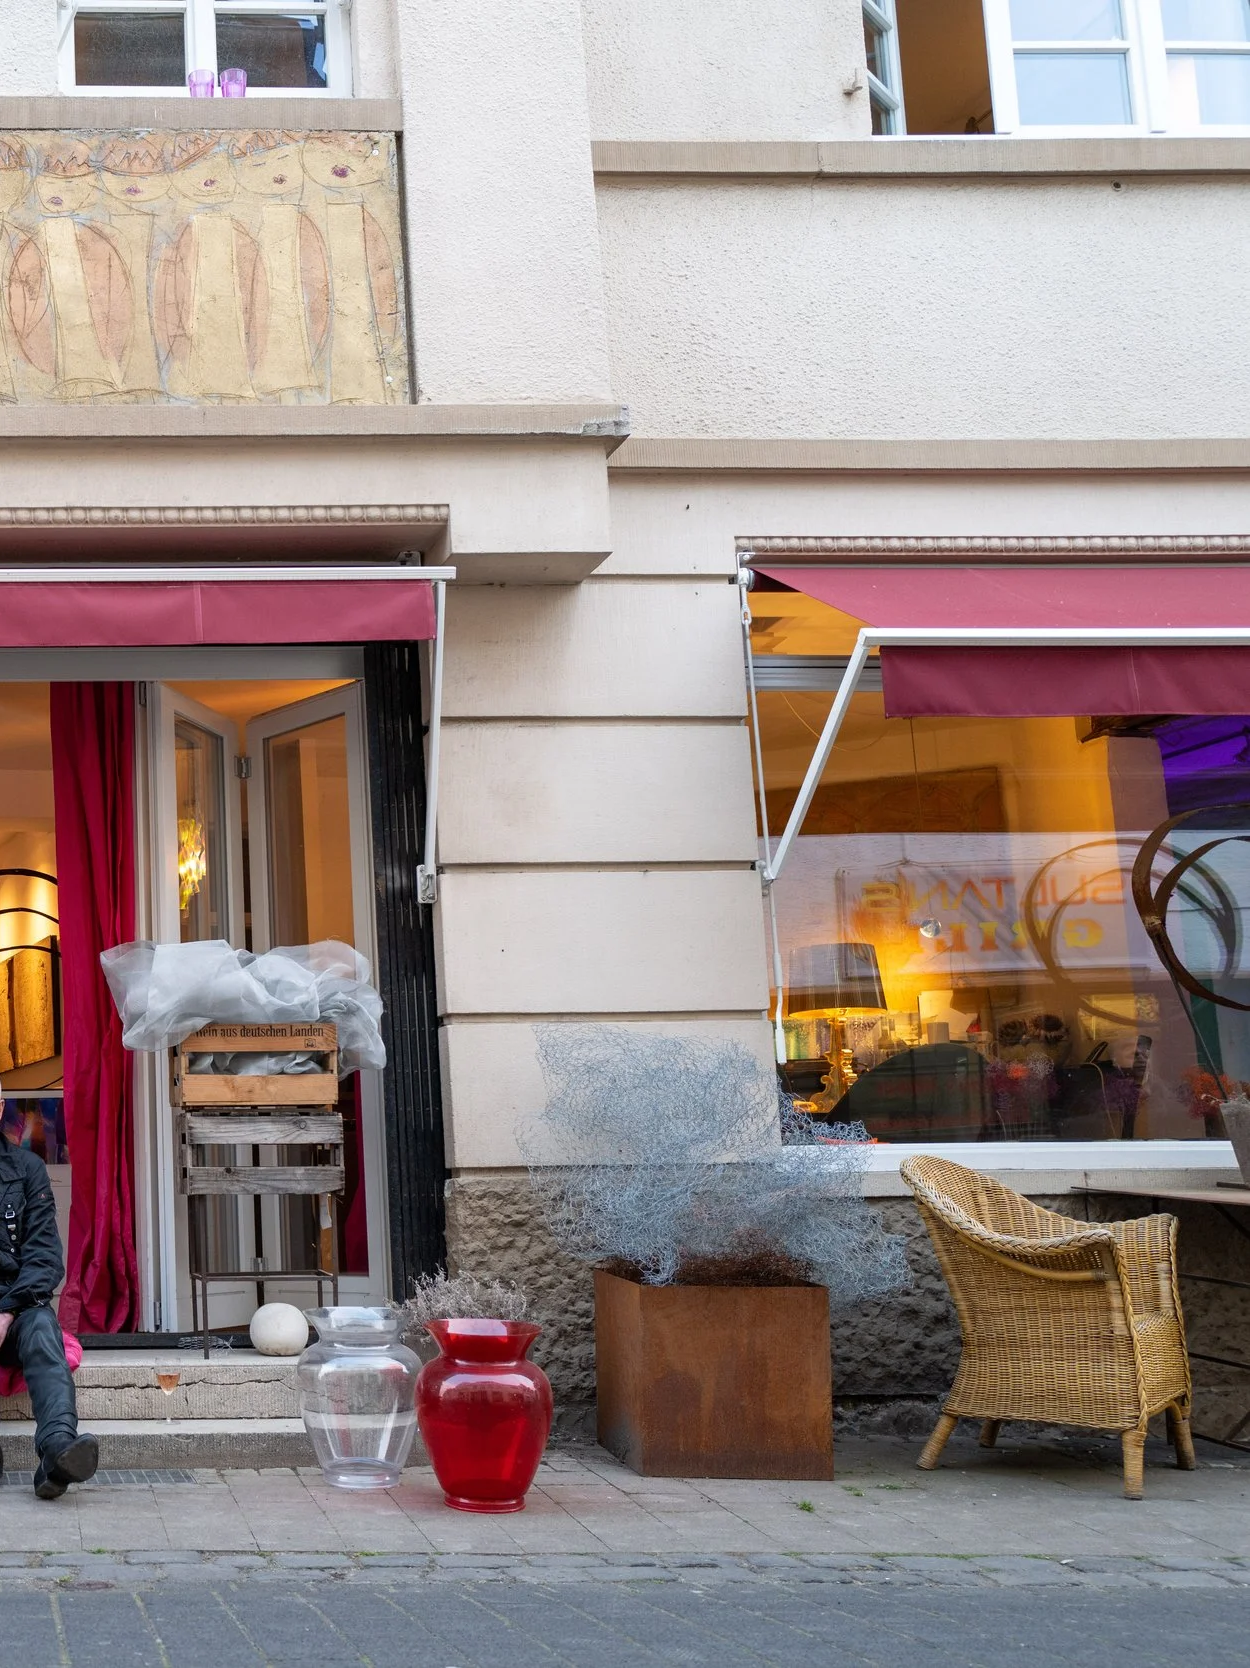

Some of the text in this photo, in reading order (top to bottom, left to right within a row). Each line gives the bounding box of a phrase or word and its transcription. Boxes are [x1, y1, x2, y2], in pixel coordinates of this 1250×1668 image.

[220, 1027, 238, 1038] aus
[240, 1023, 287, 1038] deutschen
[290, 1024, 324, 1038] Landen
